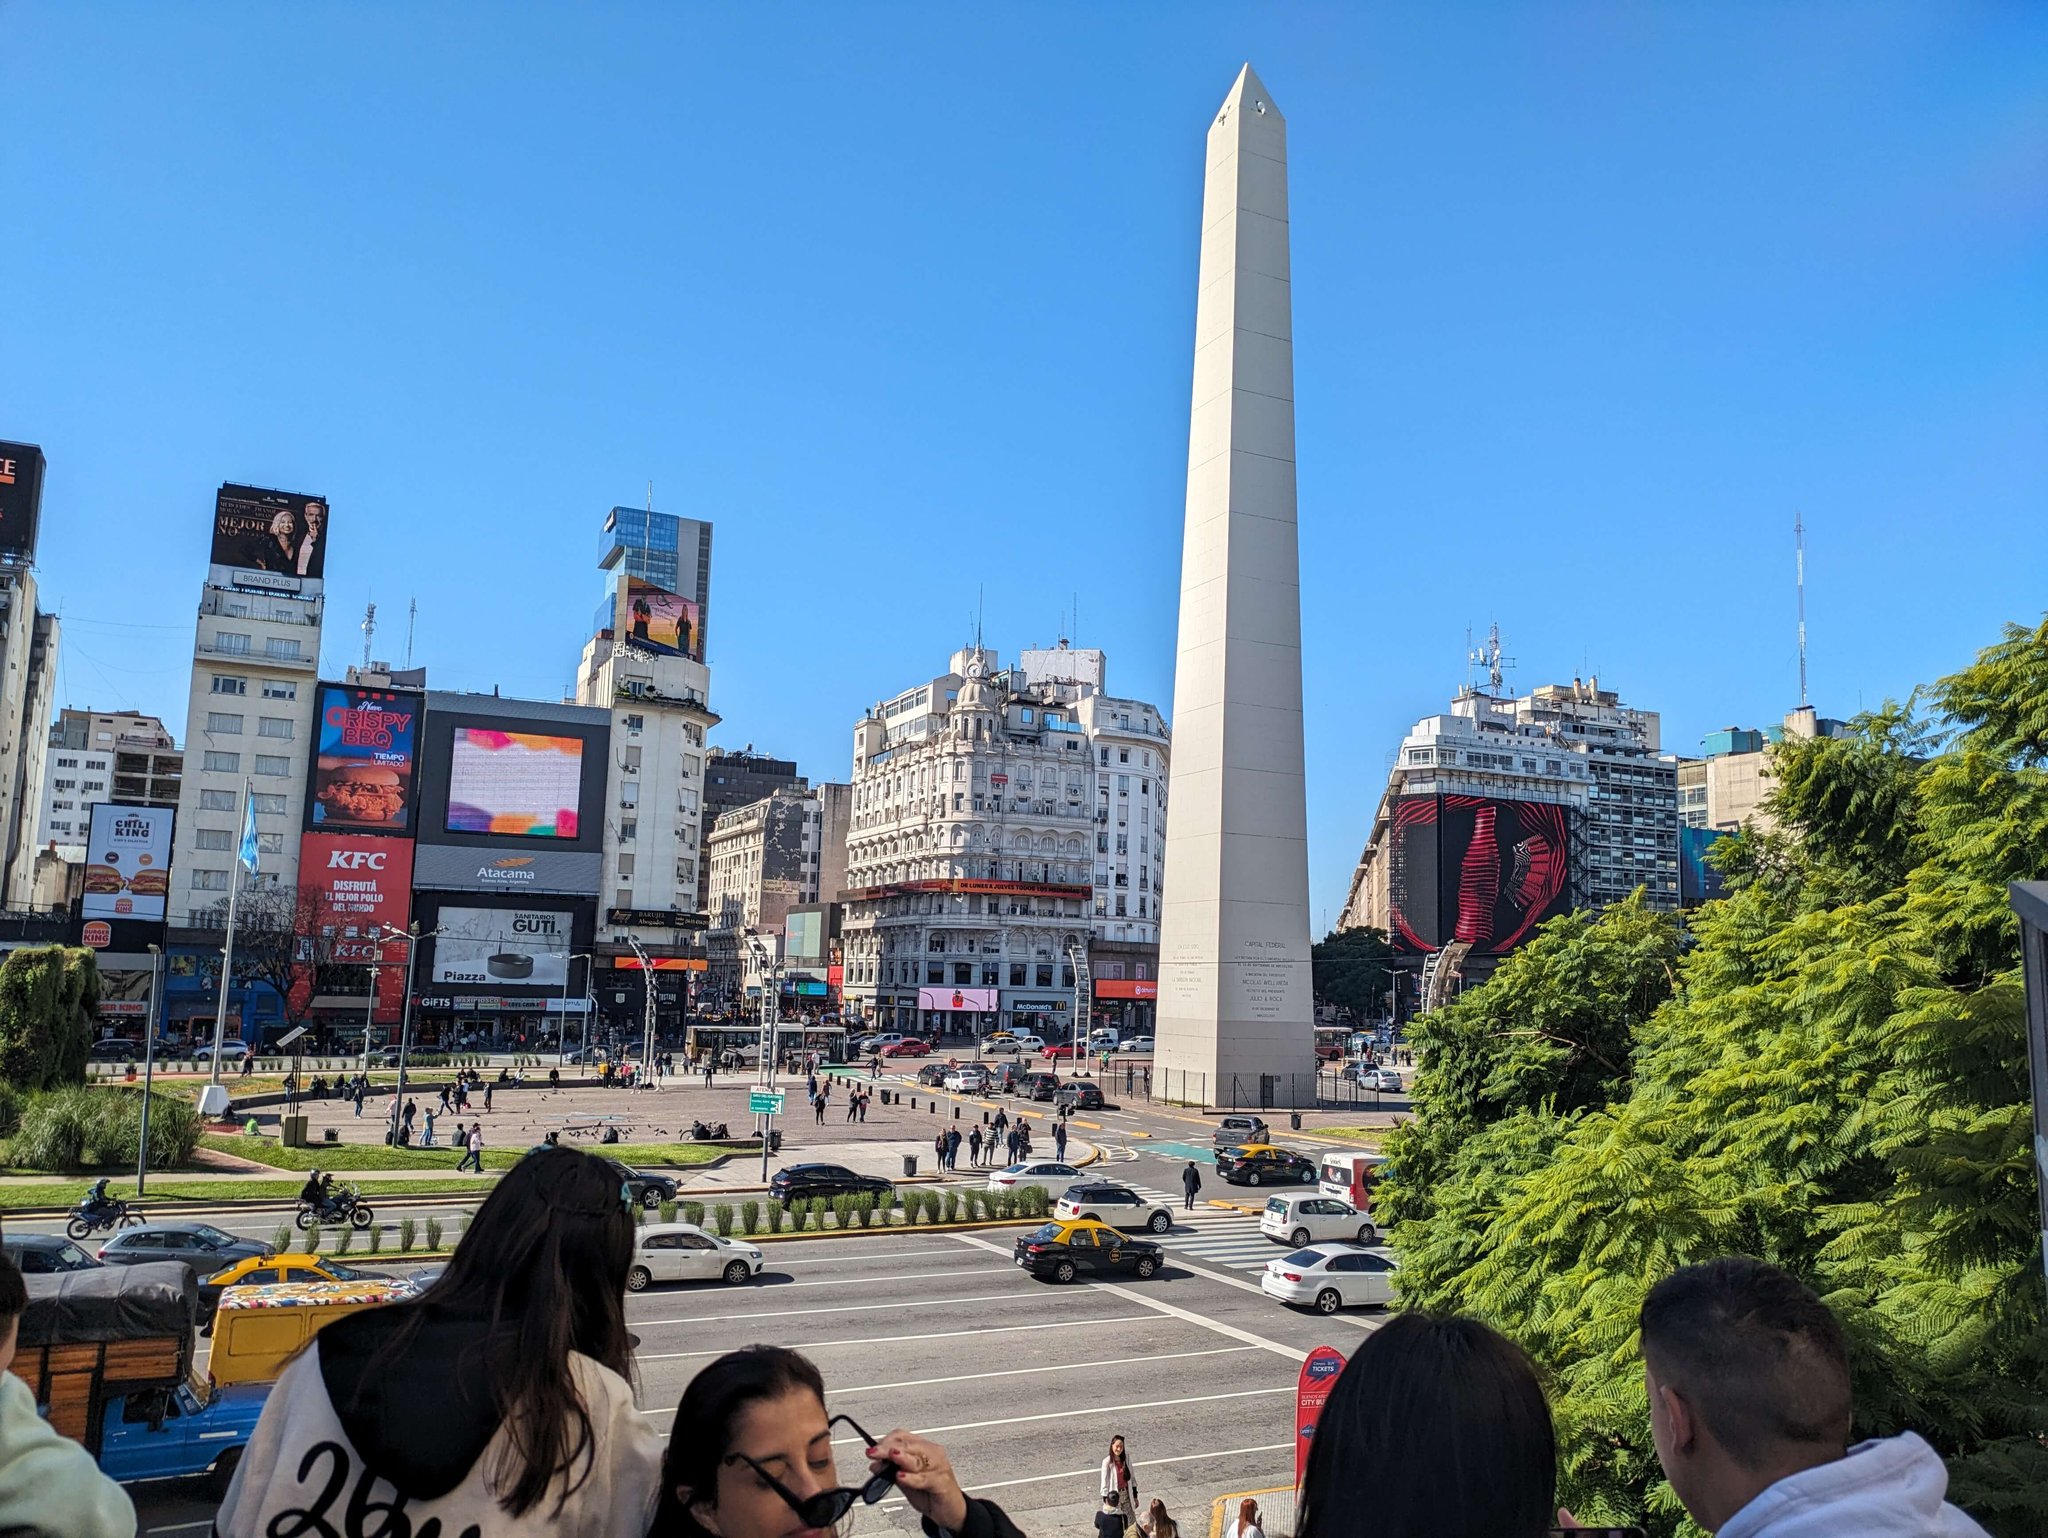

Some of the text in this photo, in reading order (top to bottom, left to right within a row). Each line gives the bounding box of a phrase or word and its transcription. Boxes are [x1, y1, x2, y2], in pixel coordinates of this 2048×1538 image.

[218, 515, 265, 531] MEJOR
[217, 525, 239, 537] NO
[243, 574, 291, 587] BRAND PLUS
[326, 706, 411, 732] CRISPY
[342, 727, 392, 749] BBQ
[374, 752, 405, 761] TIEMPO
[115, 819, 150, 829] CHILI
[115, 827, 150, 838] KING
[327, 850, 387, 870] KFC
[477, 867, 535, 880] Atacama
[333, 879, 377, 892] DISFRUTÁ
[335, 892, 359, 902] MEJOR
[360, 893, 384, 903] POLLO
[332, 903, 346, 912] DEL
[514, 913, 555, 921] SANITARIOS
[638, 918, 665, 926] Abogados
[84, 927, 110, 936] BURGER
[83, 934, 109, 942] KING
[335, 943, 375, 957] KFC
[443, 971, 486, 982] Piazza
[119, 1003, 143, 1012] KING
[1016, 1003, 1052, 1011] McDonald's
